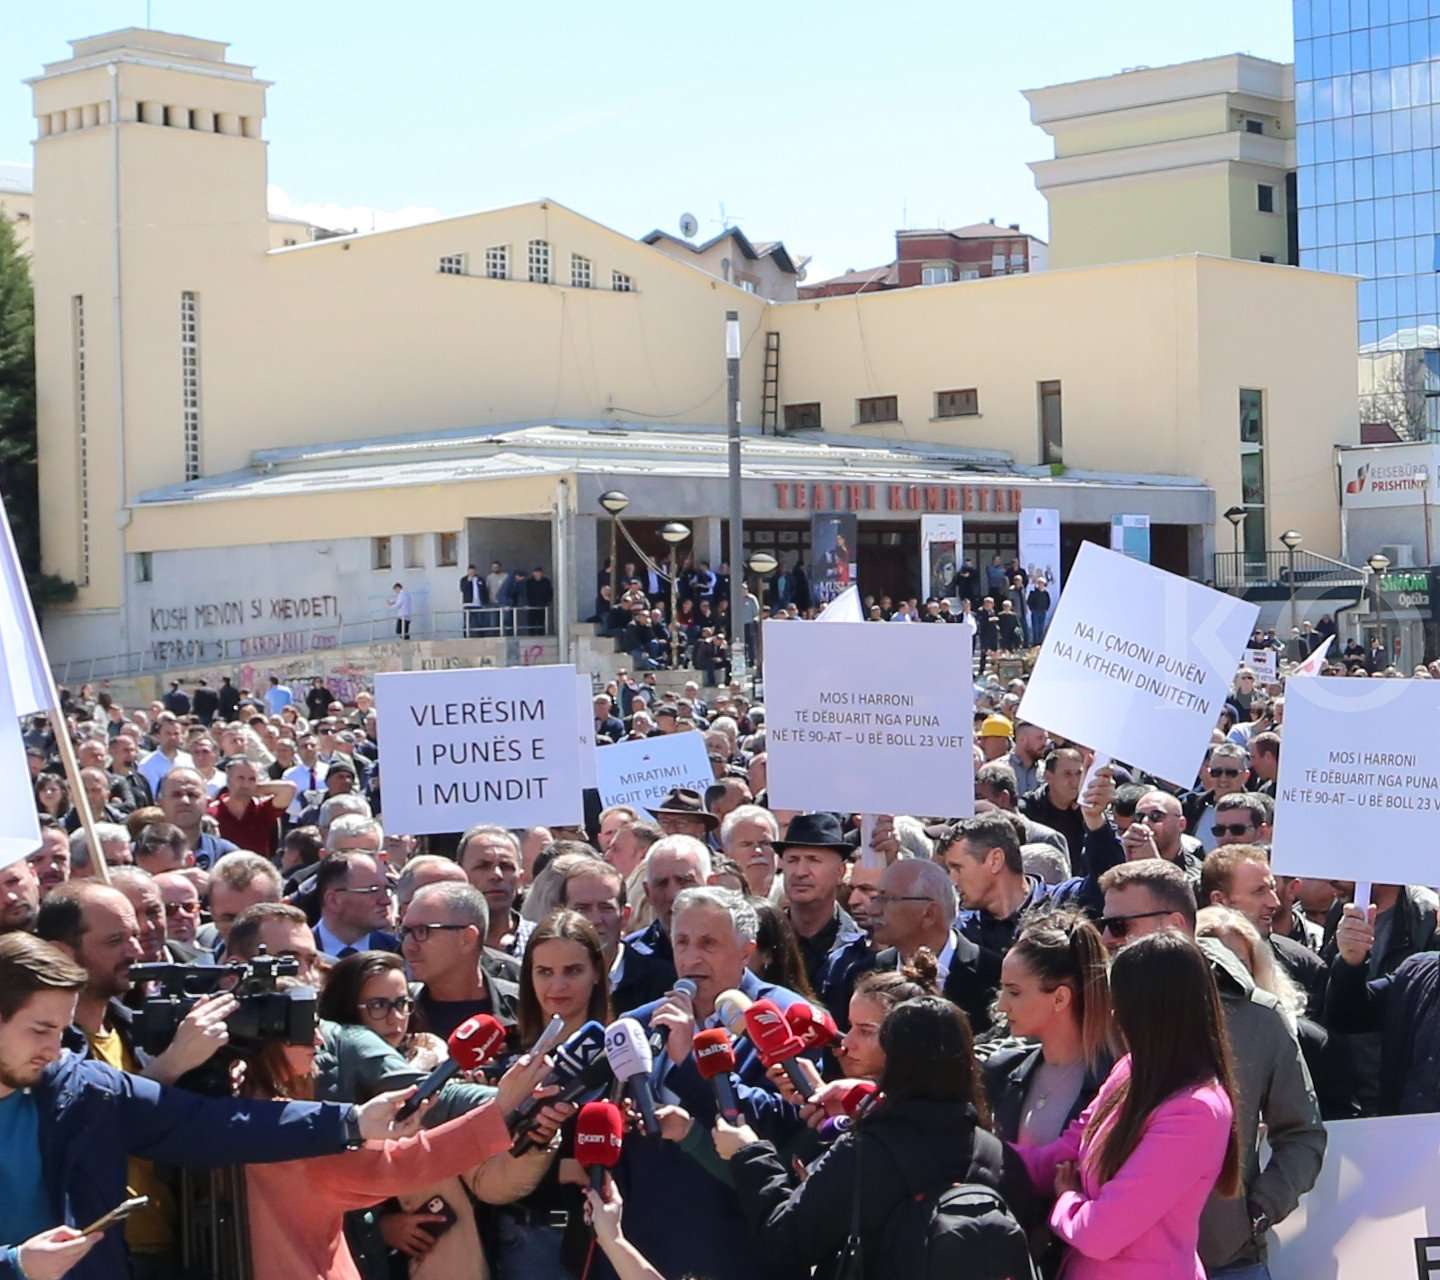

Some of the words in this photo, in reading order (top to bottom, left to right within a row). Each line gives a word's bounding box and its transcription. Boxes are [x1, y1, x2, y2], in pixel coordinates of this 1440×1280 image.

[774, 481, 876, 511] TEATRI
[1398, 593, 1430, 608] Optika
[150, 605, 188, 632] KUSH
[195, 600, 243, 628] MENON
[251, 598, 262, 619] SI
[1074, 621, 1095, 642] NA
[1096, 631, 1104, 644] I
[1105, 634, 1154, 665] ÇMONI
[1155, 653, 1207, 685] PUNËN
[1053, 640, 1073, 661] NA
[1075, 649, 1083, 662] I
[1082, 652, 1134, 684] KTHENI
[1135, 673, 1210, 715] DINJITETIN
[819, 691, 849, 705] MOS
[859, 693, 914, 707] HARRONI
[410, 697, 545, 727] VLERËSIM
[795, 710, 809, 724] TË
[812, 711, 872, 726] DËBUARIT
[875, 713, 902, 727] NGA
[905, 714, 940, 728] PUNA
[772, 728, 789, 742] NË
[792, 728, 806, 742] TË
[809, 731, 842, 744] 90-AT
[856, 733, 865, 745] U
[869, 732, 882, 746] BË
[886, 734, 917, 747] BOLL
[919, 735, 934, 747] 23
[937, 736, 964, 748] VJET
[416, 744, 422, 766] I
[432, 735, 522, 766] PUNËS
[531, 738, 545, 760] E
[1329, 751, 1356, 765] MOS
[1364, 753, 1416, 767] HARRONI
[619, 766, 681, 787] MIRATIMI
[1305, 770, 1317, 783] TË
[1320, 770, 1375, 786] DËBUARIT
[1377, 773, 1403, 787] NGA
[1405, 776, 1439, 789] PUNA
[417, 784, 423, 806] I
[433, 776, 549, 805] MUNDIT
[605, 790, 642, 808] LIGJIT
[645, 782, 669, 800] PËR
[1282, 789, 1297, 802] NË
[1300, 789, 1313, 803] TË
[1315, 792, 1345, 805] 90-AT
[1358, 794, 1366, 806] U
[1369, 794, 1383, 807] BË
[1386, 796, 1414, 810] BOLL
[1417, 797, 1431, 811] 23
